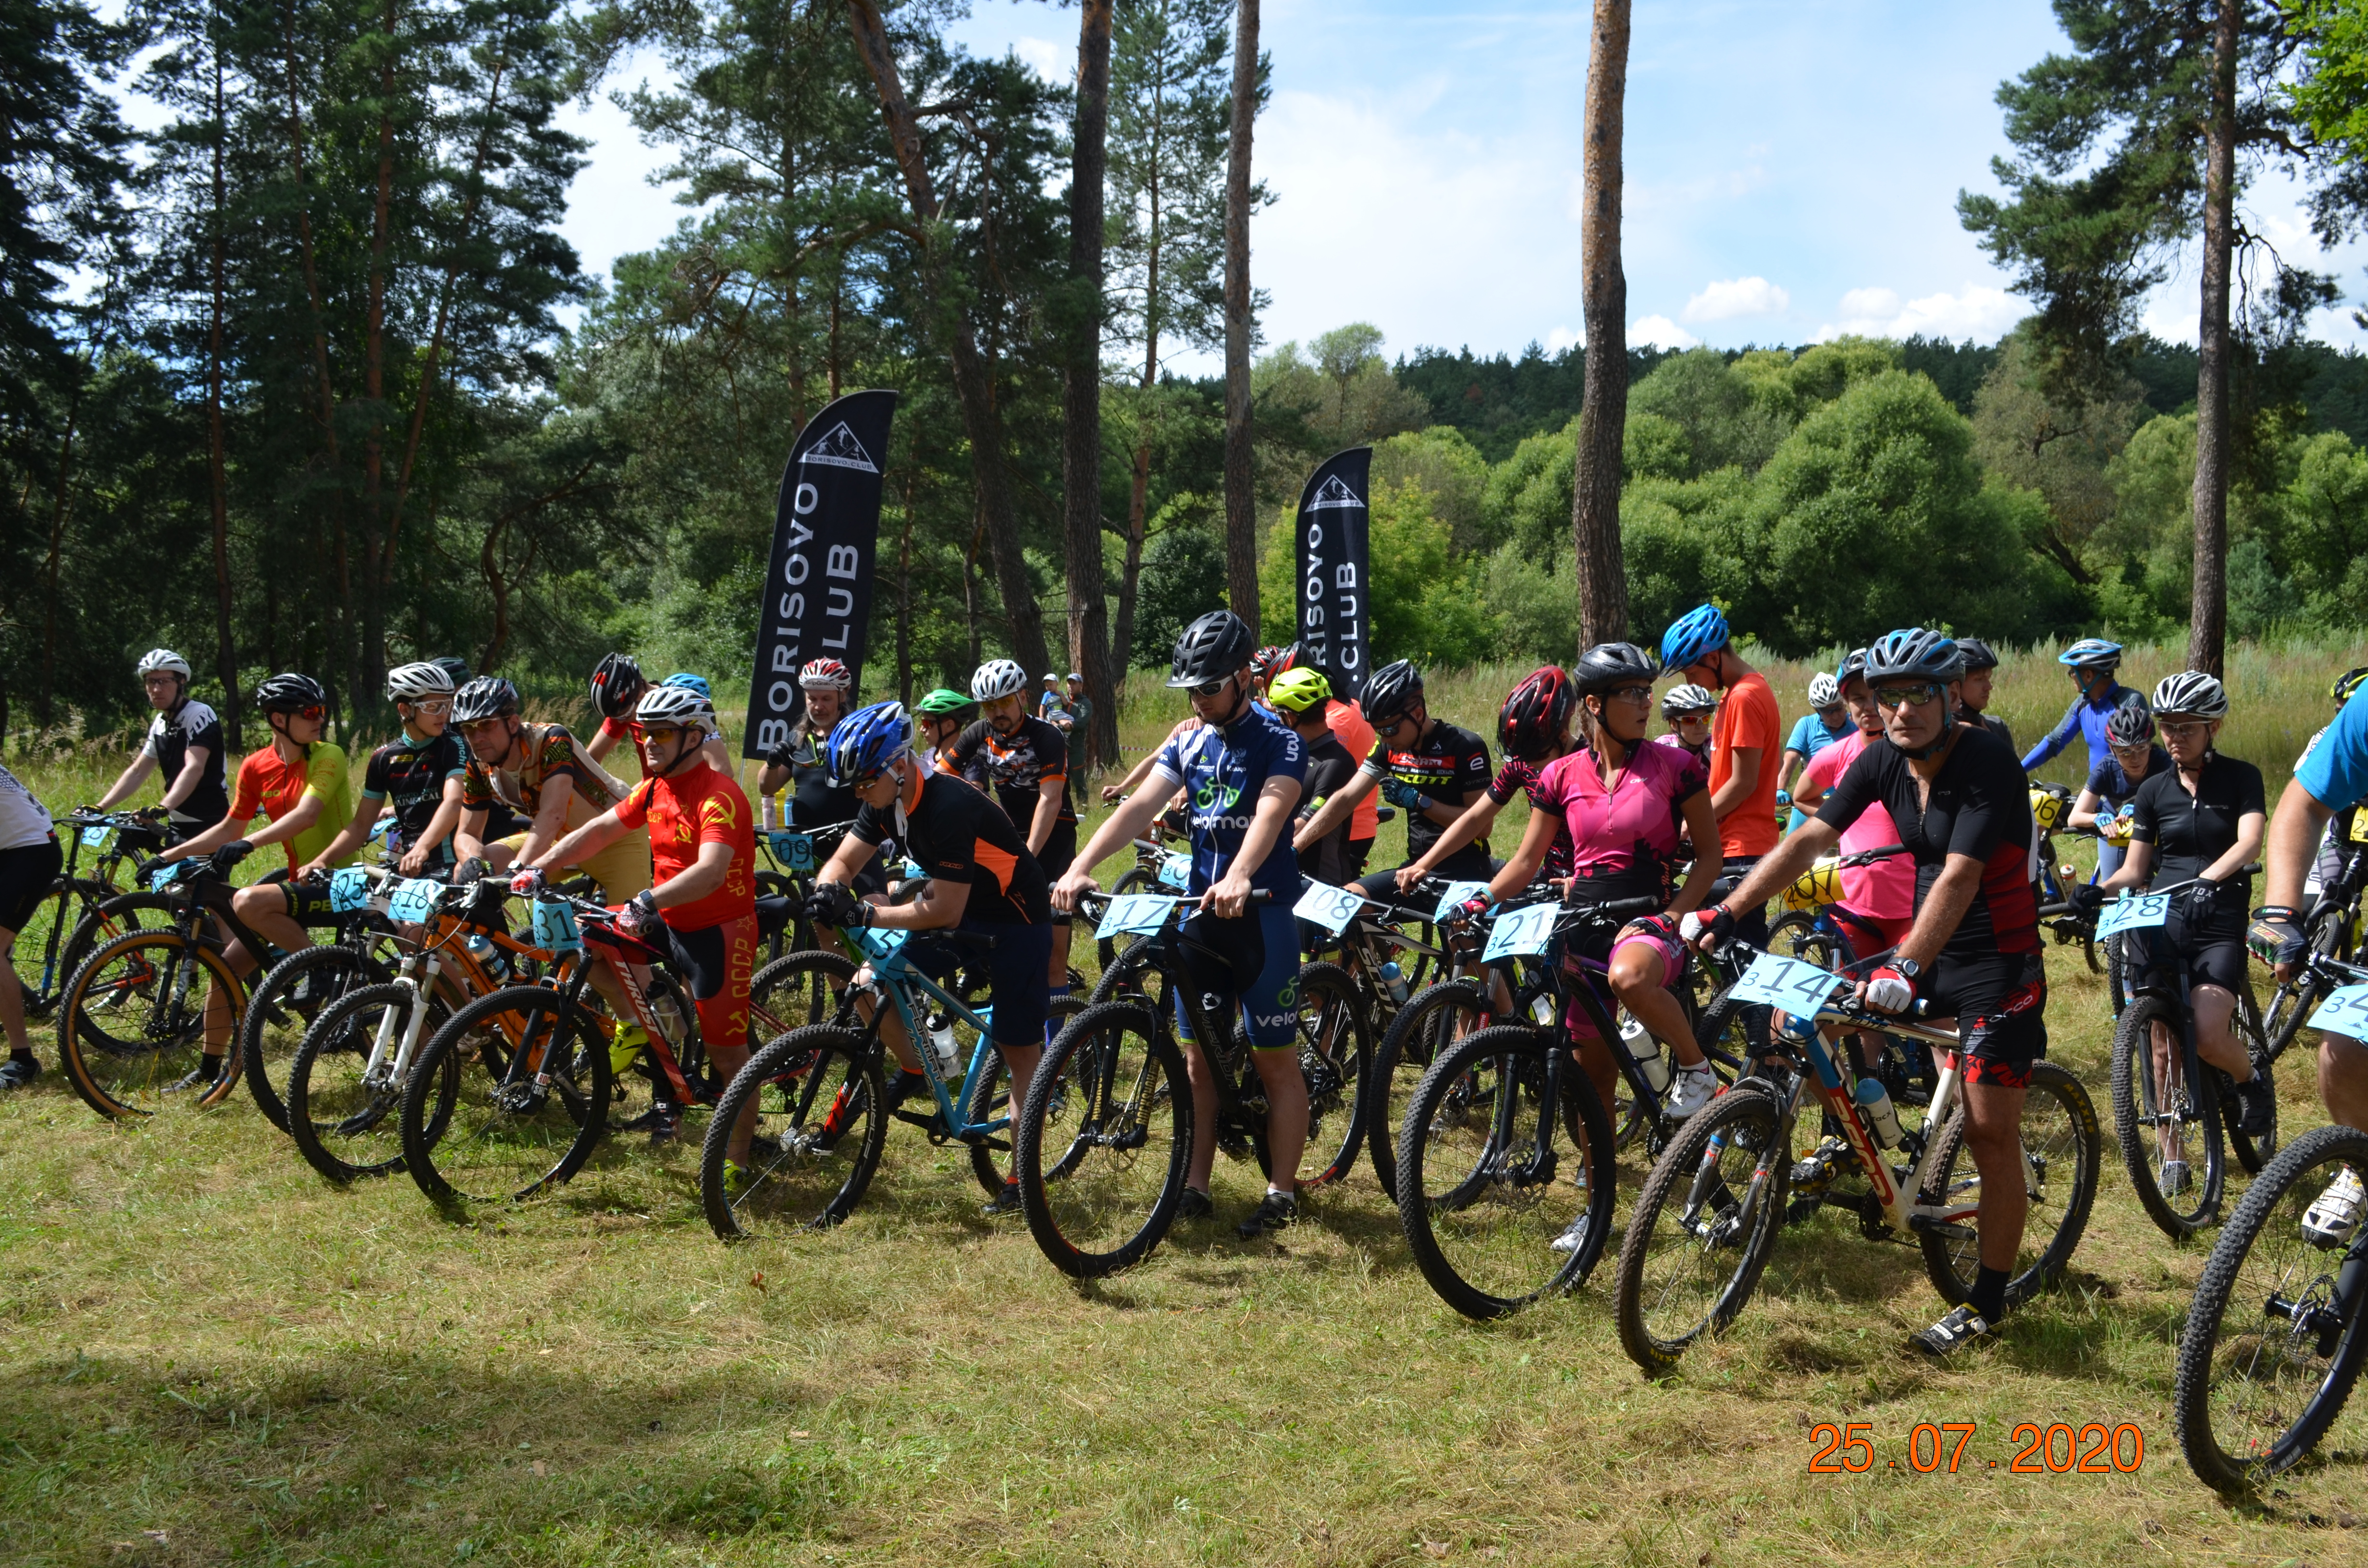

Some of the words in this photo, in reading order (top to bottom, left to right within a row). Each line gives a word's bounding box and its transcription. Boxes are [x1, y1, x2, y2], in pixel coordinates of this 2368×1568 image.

[822, 544, 859, 659] LUB
[1307, 524, 1326, 666] RISOVO
[757, 482, 818, 751] BORISOVO
[1227, 764, 1246, 773] Kaluga
[1399, 755, 1443, 766] SRAM
[1394, 773, 1452, 785] SCOTT
[260, 789, 281, 798] PBO
[2191, 887, 2214, 898] FOX
[308, 899, 332, 913] PB
[615, 960, 662, 1038] THRUST
[1989, 994, 2034, 1023] orca
[1479, 1014, 1487, 1030] reme
[1849, 1016, 1887, 1031] ELITE
[909, 1003, 945, 1085] FORMAT
[1196, 1007, 1240, 1090] MERIDA
[2062, 1083, 2095, 1134] MAXXIS
